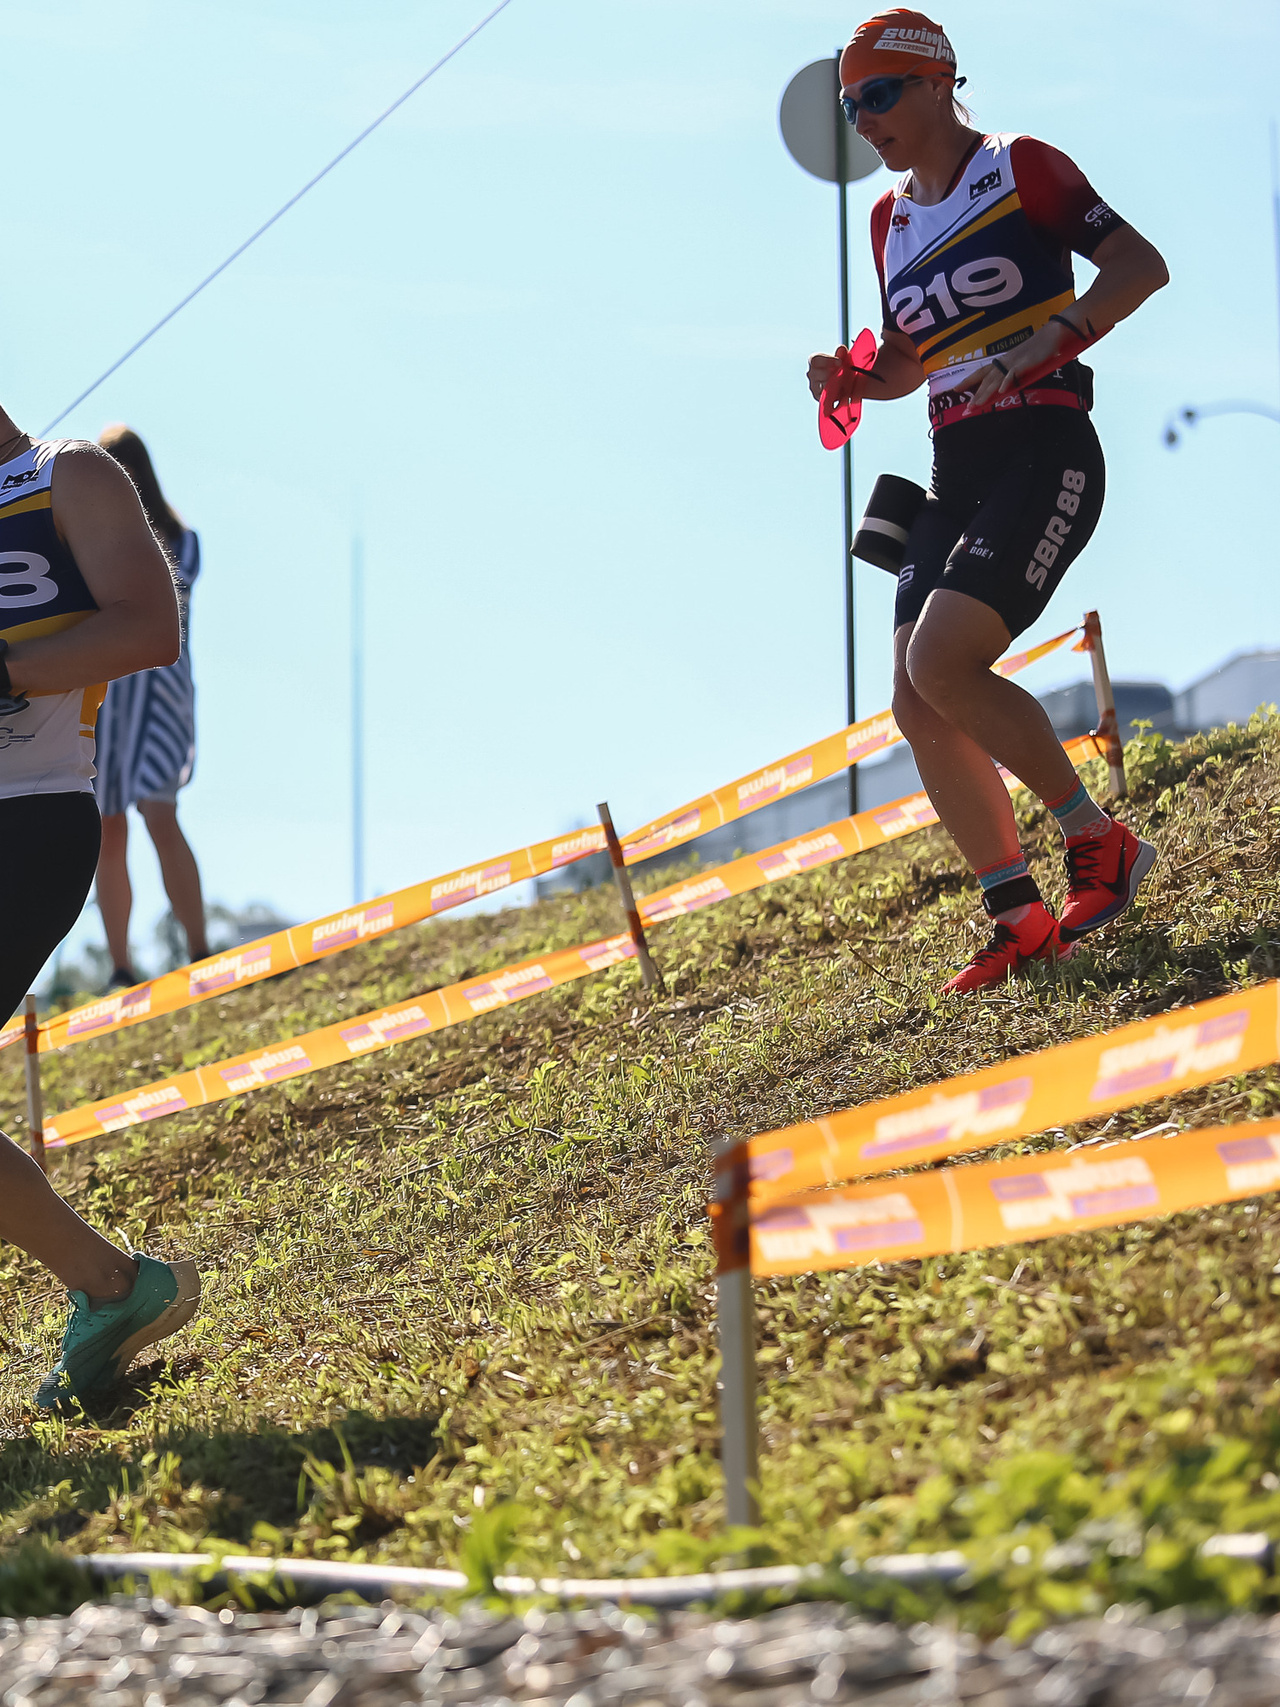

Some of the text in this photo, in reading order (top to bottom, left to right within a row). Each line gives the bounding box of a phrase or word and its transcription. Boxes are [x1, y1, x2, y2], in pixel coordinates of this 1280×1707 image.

[889, 256, 1024, 336] 219
[996, 330, 1031, 352] ISLANDS
[1025, 469, 1086, 592] SBR 88
